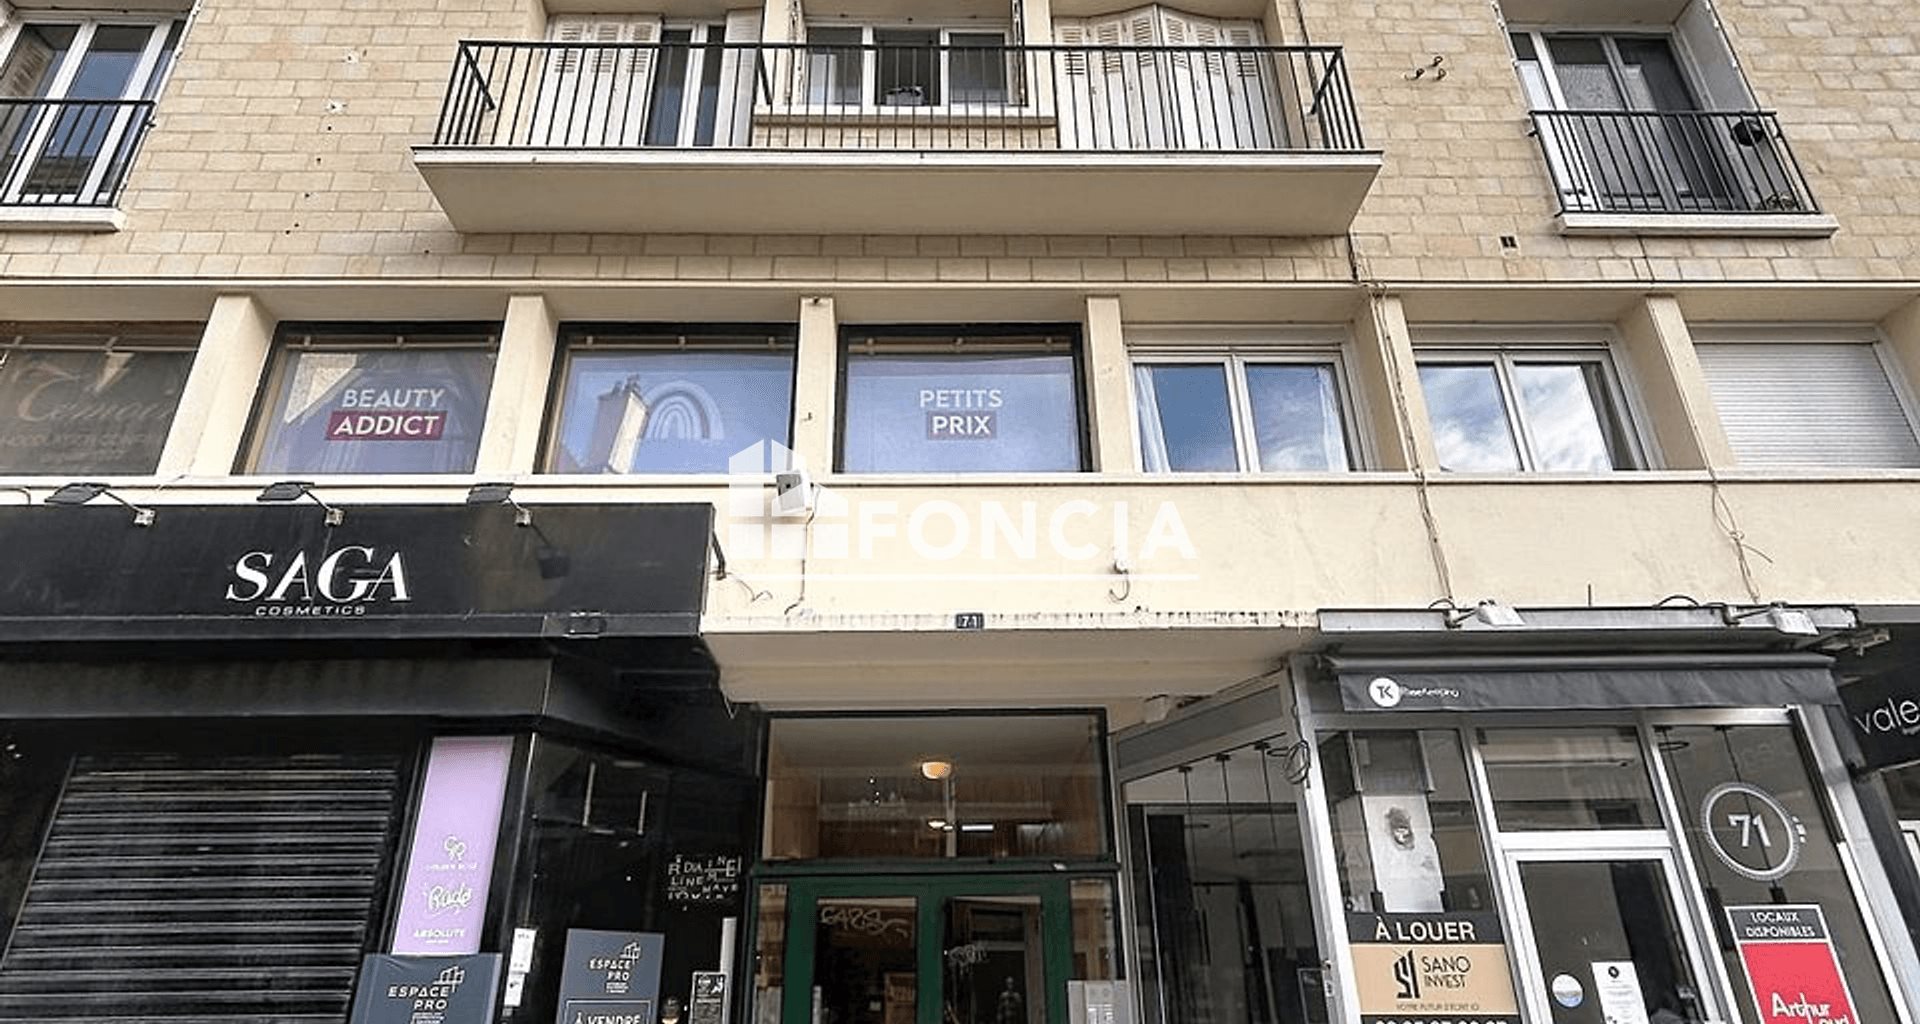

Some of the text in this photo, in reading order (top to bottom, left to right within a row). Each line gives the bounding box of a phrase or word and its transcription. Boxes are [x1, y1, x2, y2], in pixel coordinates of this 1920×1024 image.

[342, 388, 445, 408] BEAUTY
[920, 389, 1003, 408] PETITS
[333, 415, 440, 435] ADDICT
[933, 415, 992, 435] PRIX
[225, 545, 412, 603] SAGA
[255, 605, 366, 616] COSMETICS
[1727, 814, 1772, 848] 71
[1750, 911, 1801, 922] LOCAUX
[1375, 915, 1476, 941] À LOUER
[587, 958, 632, 970] ESPACE
[1421, 955, 1471, 973] SANO
[607, 971, 631, 981] PRO
[1424, 974, 1467, 988] INVEST
[387, 986, 450, 998] ESPACE
[414, 999, 448, 1011] PRO
[1771, 991, 1832, 1020] Arthur
